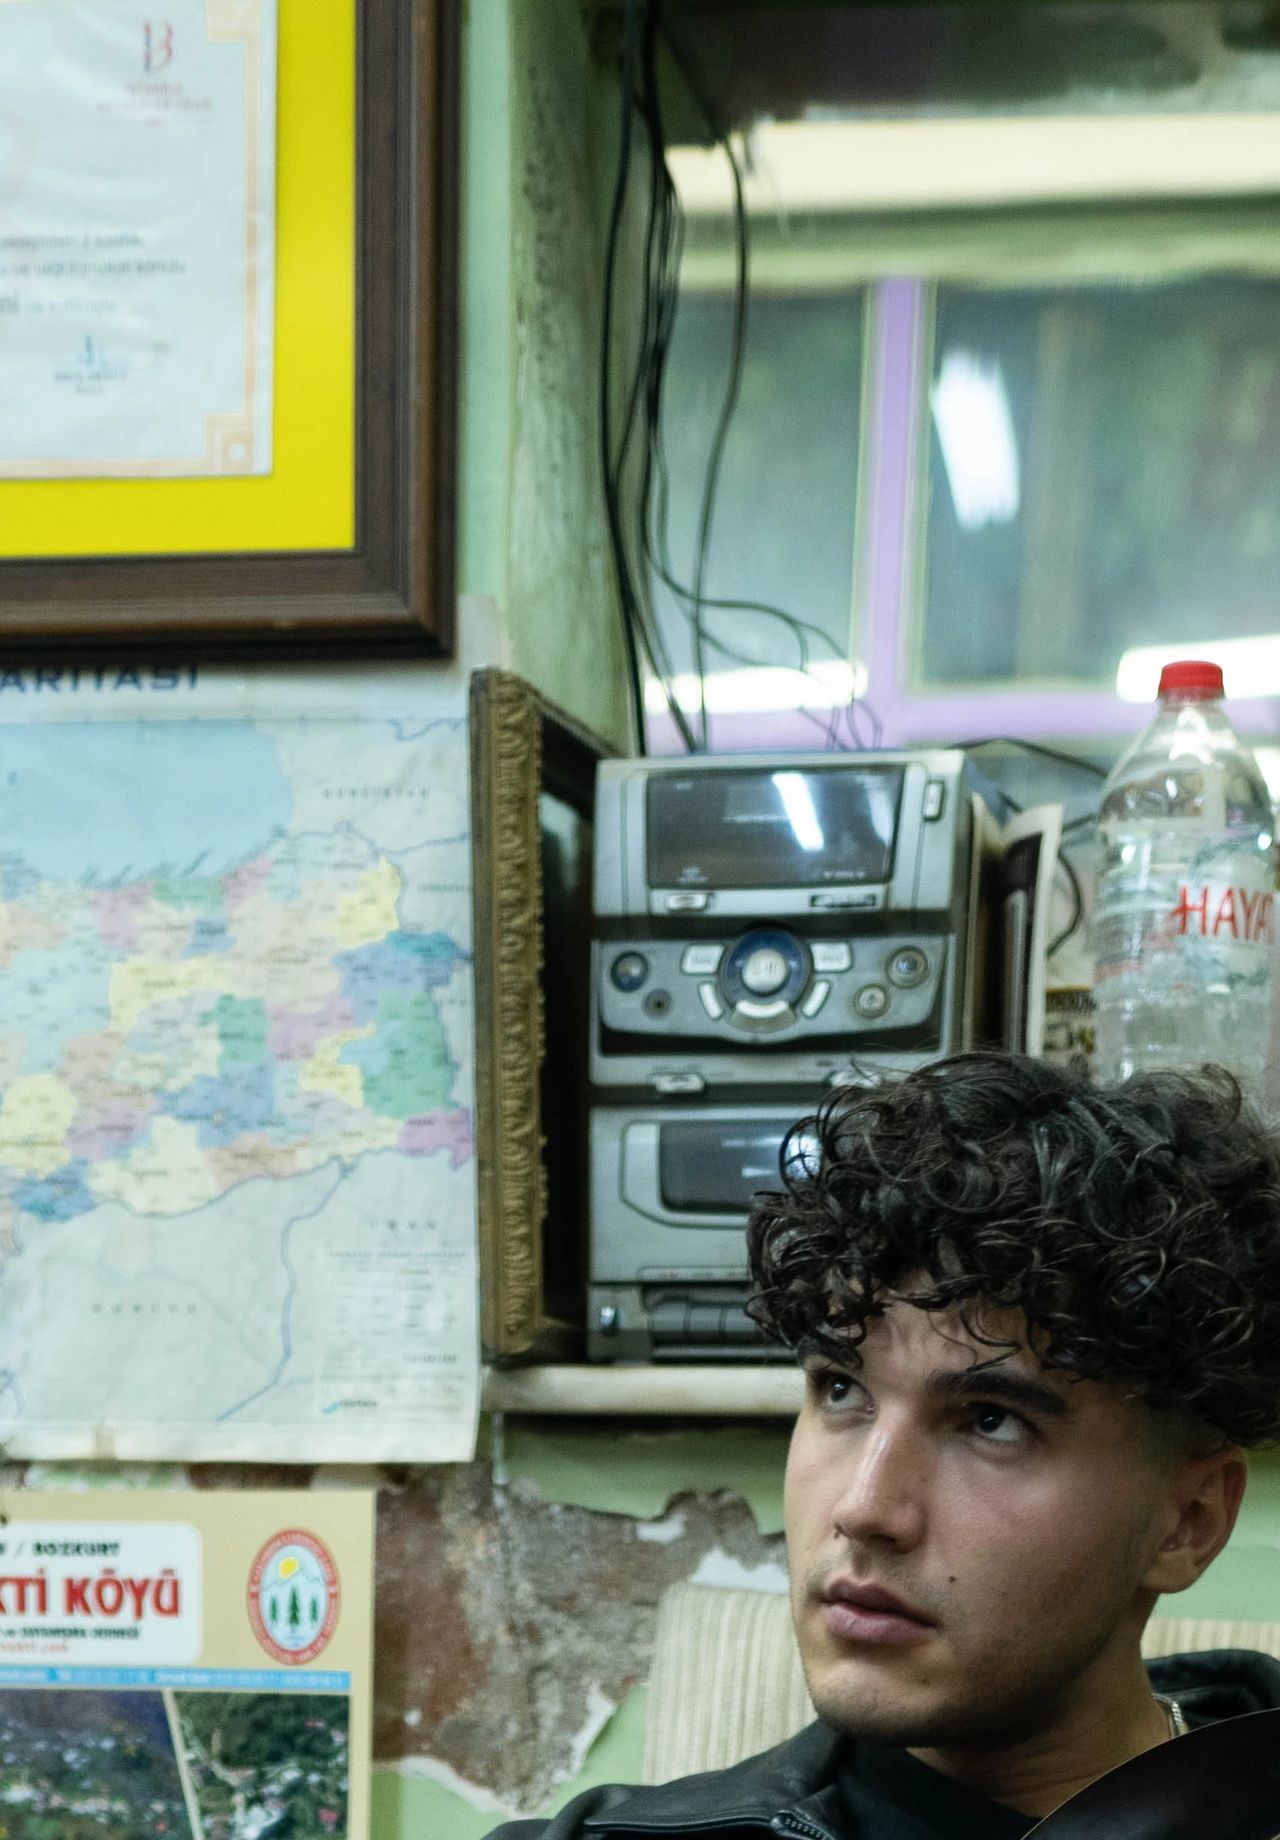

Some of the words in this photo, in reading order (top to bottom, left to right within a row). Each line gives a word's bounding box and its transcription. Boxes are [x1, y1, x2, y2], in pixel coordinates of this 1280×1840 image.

[1174, 886, 1273, 944] HAYA
[33, 1541, 121, 1557] BOZKURT
[64, 1567, 181, 1621] KÖYÜ
